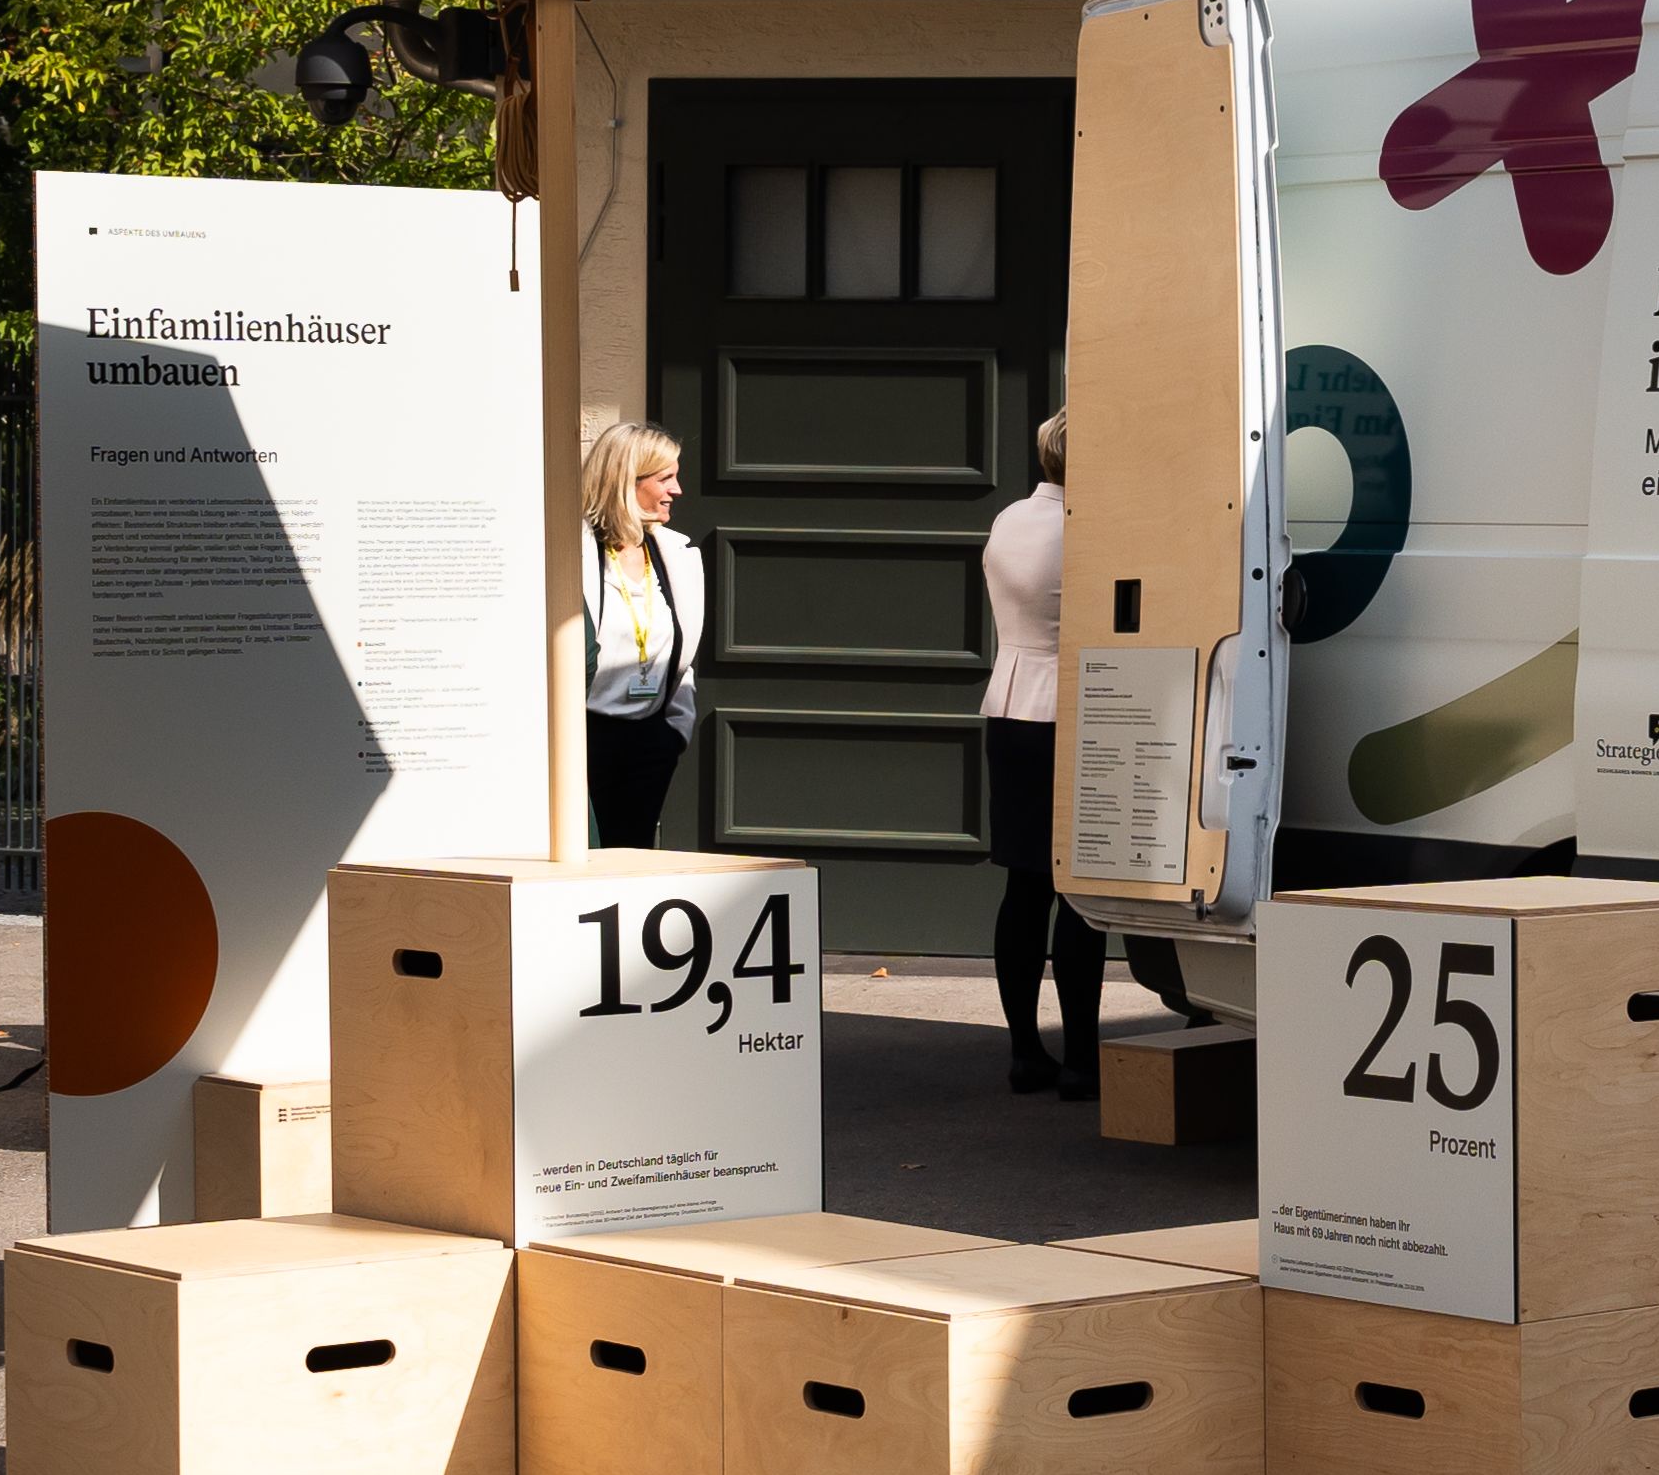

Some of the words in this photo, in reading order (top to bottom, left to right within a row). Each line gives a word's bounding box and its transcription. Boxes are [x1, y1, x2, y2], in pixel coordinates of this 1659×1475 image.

[86, 307, 391, 344] Einfamilienhäuser
[86, 355, 240, 386] umbauen
[91, 445, 148, 466] Fragen
[154, 446, 185, 462] und
[190, 447, 277, 463] Antworten
[578, 894, 805, 1034] 19,4
[1343, 934, 1501, 1112] 25
[738, 1032, 804, 1054] Hektar
[1429, 1131, 1497, 1159] Prozent
[536, 1183, 561, 1192] neue
[565, 1180, 584, 1190] Ein-
[588, 1177, 607, 1188] und
[610, 1169, 710, 1186] Zweifamilienhäuser
[713, 1161, 778, 1177] beansprucht.
[543, 1163, 582, 1176] werden
[585, 1161, 594, 1171] in
[598, 1154, 662, 1170] Deutschland
[666, 1151, 700, 1165] täglich
[704, 1150, 717, 1160] für
[1279, 1203, 1293, 1216] der
[1369, 1215, 1396, 1230] haben
[1398, 1219, 1409, 1231] ihr
[1274, 1221, 1294, 1235] Haus
[1296, 1223, 1310, 1237] mit
[1312, 1226, 1323, 1240] 69
[1324, 1228, 1352, 1244] Jahren
[1355, 1234, 1376, 1246] noch
[1378, 1236, 1400, 1249] nicht
[1402, 1240, 1448, 1256] abbezahlt.
